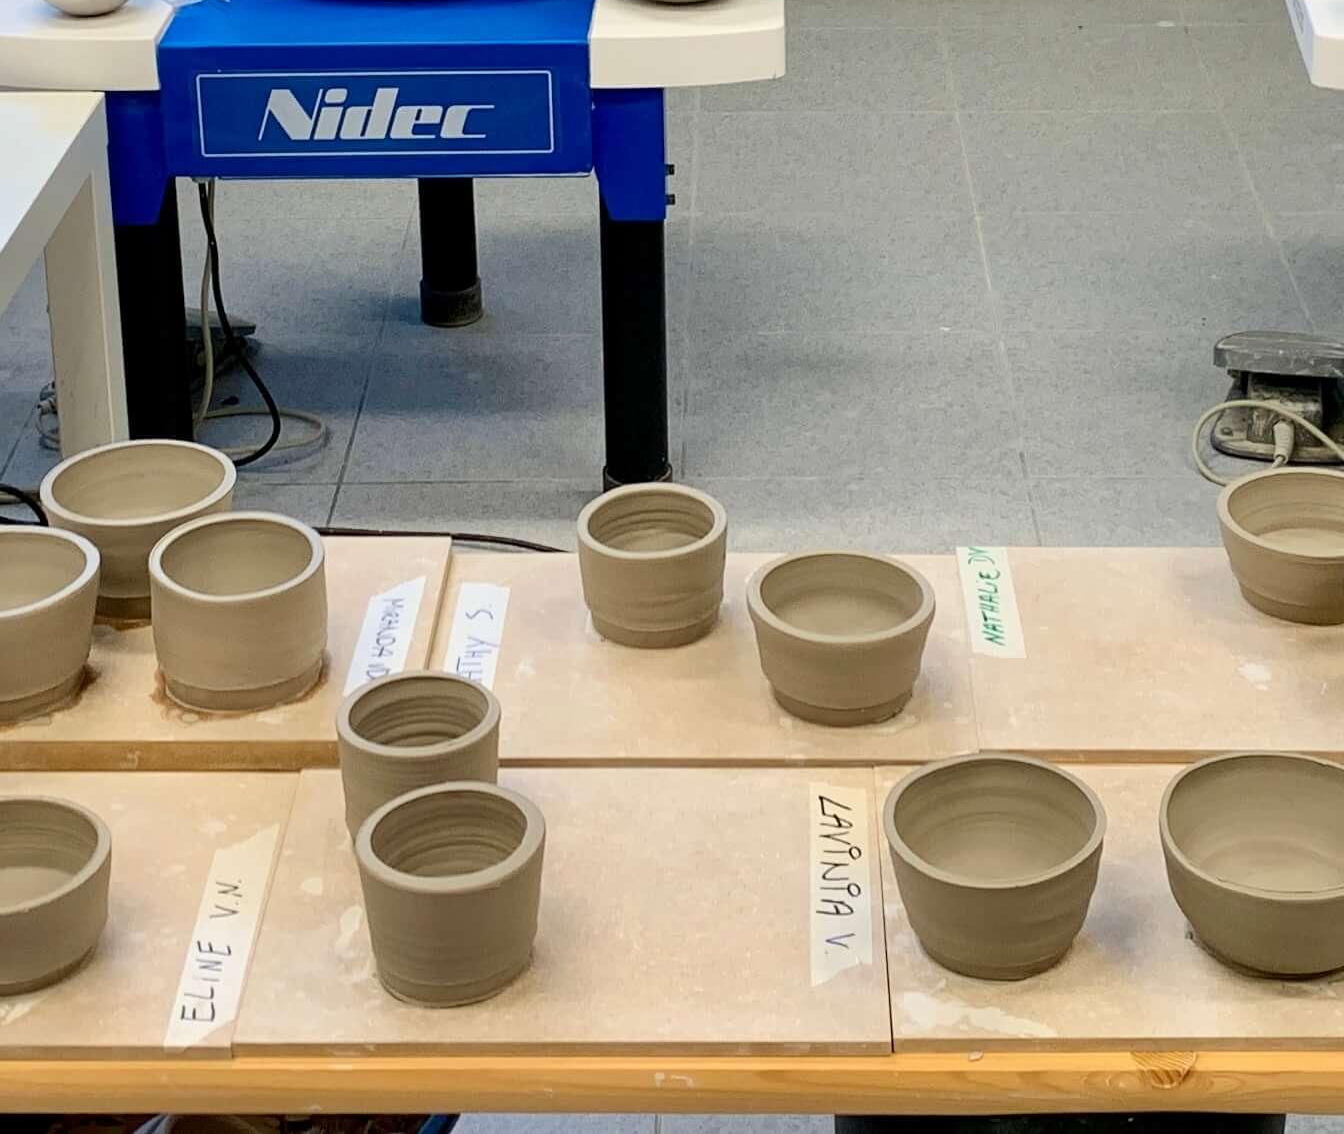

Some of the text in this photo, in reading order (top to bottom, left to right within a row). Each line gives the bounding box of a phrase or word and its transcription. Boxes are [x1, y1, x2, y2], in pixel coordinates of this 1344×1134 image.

[257, 87, 496, 142] Nidec
[455, 635, 502, 684] ATHY
[179, 939, 233, 1023] ELINE
